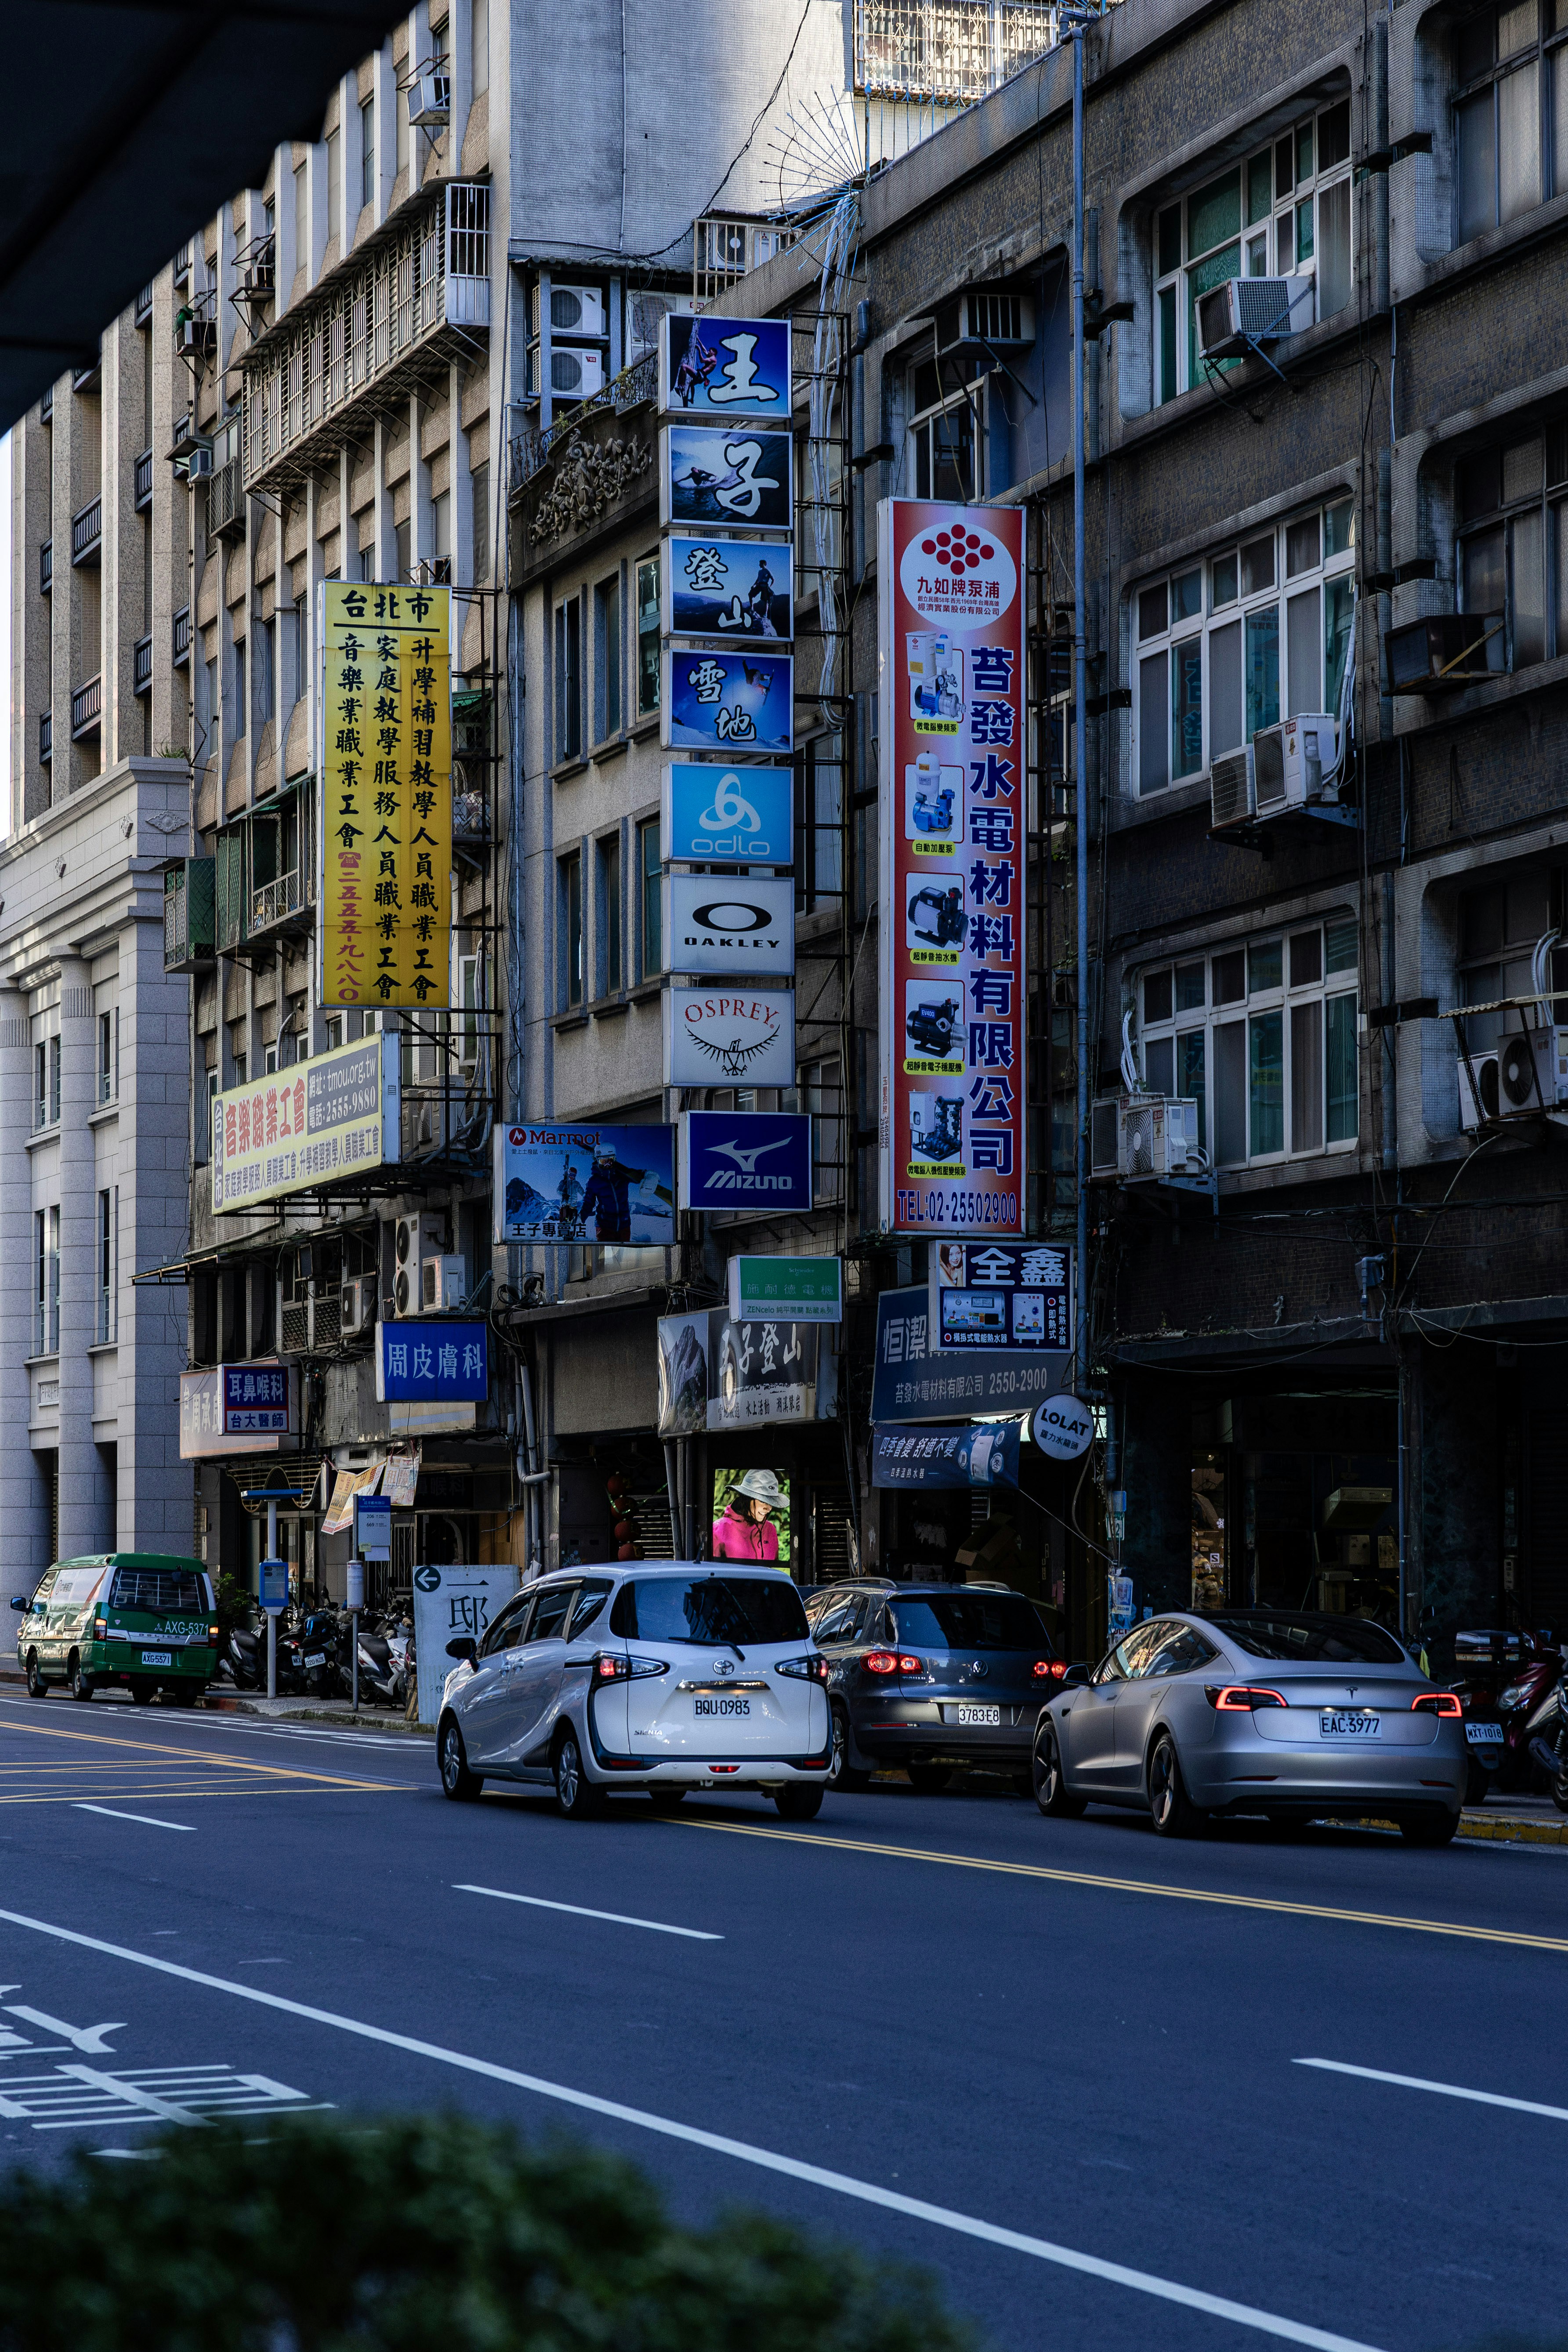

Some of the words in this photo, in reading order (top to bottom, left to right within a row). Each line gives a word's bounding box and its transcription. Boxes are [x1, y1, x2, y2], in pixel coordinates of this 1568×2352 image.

[708, 331, 779, 403] 王
[714, 439, 779, 517] 子
[917, 576, 1000, 599] 九如牌泵浦
[341, 589, 434, 623] 台北市
[918, 603, 999, 616] 經濟實業股份有限公司
[687, 658, 757, 741] 雪地
[916, 721, 957, 733] 微電腦變頻泵
[334, 633, 365, 849] 音樂業職業工會
[372, 634, 403, 1000] 家庭教學服務人員職業工會
[409, 636, 438, 1001] 升學補習教學人員職業工會
[691, 835, 770, 855] odlo
[916, 842, 953, 854] 自動加壓泵
[969, 646, 1015, 1176] 苔發水電材料有限公司
[684, 937, 780, 948] OAKLEY
[913, 951, 958, 963] 超靜音抽水機
[684, 998, 780, 1026] OSPREY
[921, 1009, 934, 1018] EV400
[327, 1055, 377, 1091] tmou.org.tw
[906, 1061, 962, 1073] 超靜音電子穩壓機
[225, 1077, 305, 1158] 音樂職業工會
[529, 1131, 601, 1145] Marmot
[703, 1170, 792, 1190] MIZUNO
[898, 1189, 1016, 1225] TEL:02-25502900
[511, 1222, 587, 1238] 王子專賣店
[970, 1247, 1065, 1287] 全鑫
[746, 1283, 833, 1296] 施耐德電機
[1058, 1294, 1066, 1345] 電能熱水器
[953, 1333, 1007, 1344] 橫掛式電能熱水器
[388, 1343, 483, 1379] 周皮膚科
[229, 1374, 283, 1402] 耳鼻喉科
[895, 1375, 983, 1404] 苔發水電材料有限公司
[989, 1367, 1047, 1395] 2550-2900
[746, 1398, 770, 1417] 水上活動
[231, 1413, 283, 1428] 台大醫師
[1040, 1407, 1089, 1437] LOLAT
[879, 1436, 916, 1458] 四季會變
[913, 1435, 960, 1458] 舒適不變
[1040, 1428, 1079, 1451] 羅力水龍頭
[447, 1580, 489, 1635] 一邸
[165, 1621, 209, 1635] AXG-5371
[143, 1653, 170, 1664] AXG-5371
[695, 1700, 750, 1715] BQU-0983
[960, 1709, 999, 1721] 3783-E8
[1322, 1718, 1380, 1732] EAC-3977
[1468, 1728, 1502, 1739] MXT-1018
